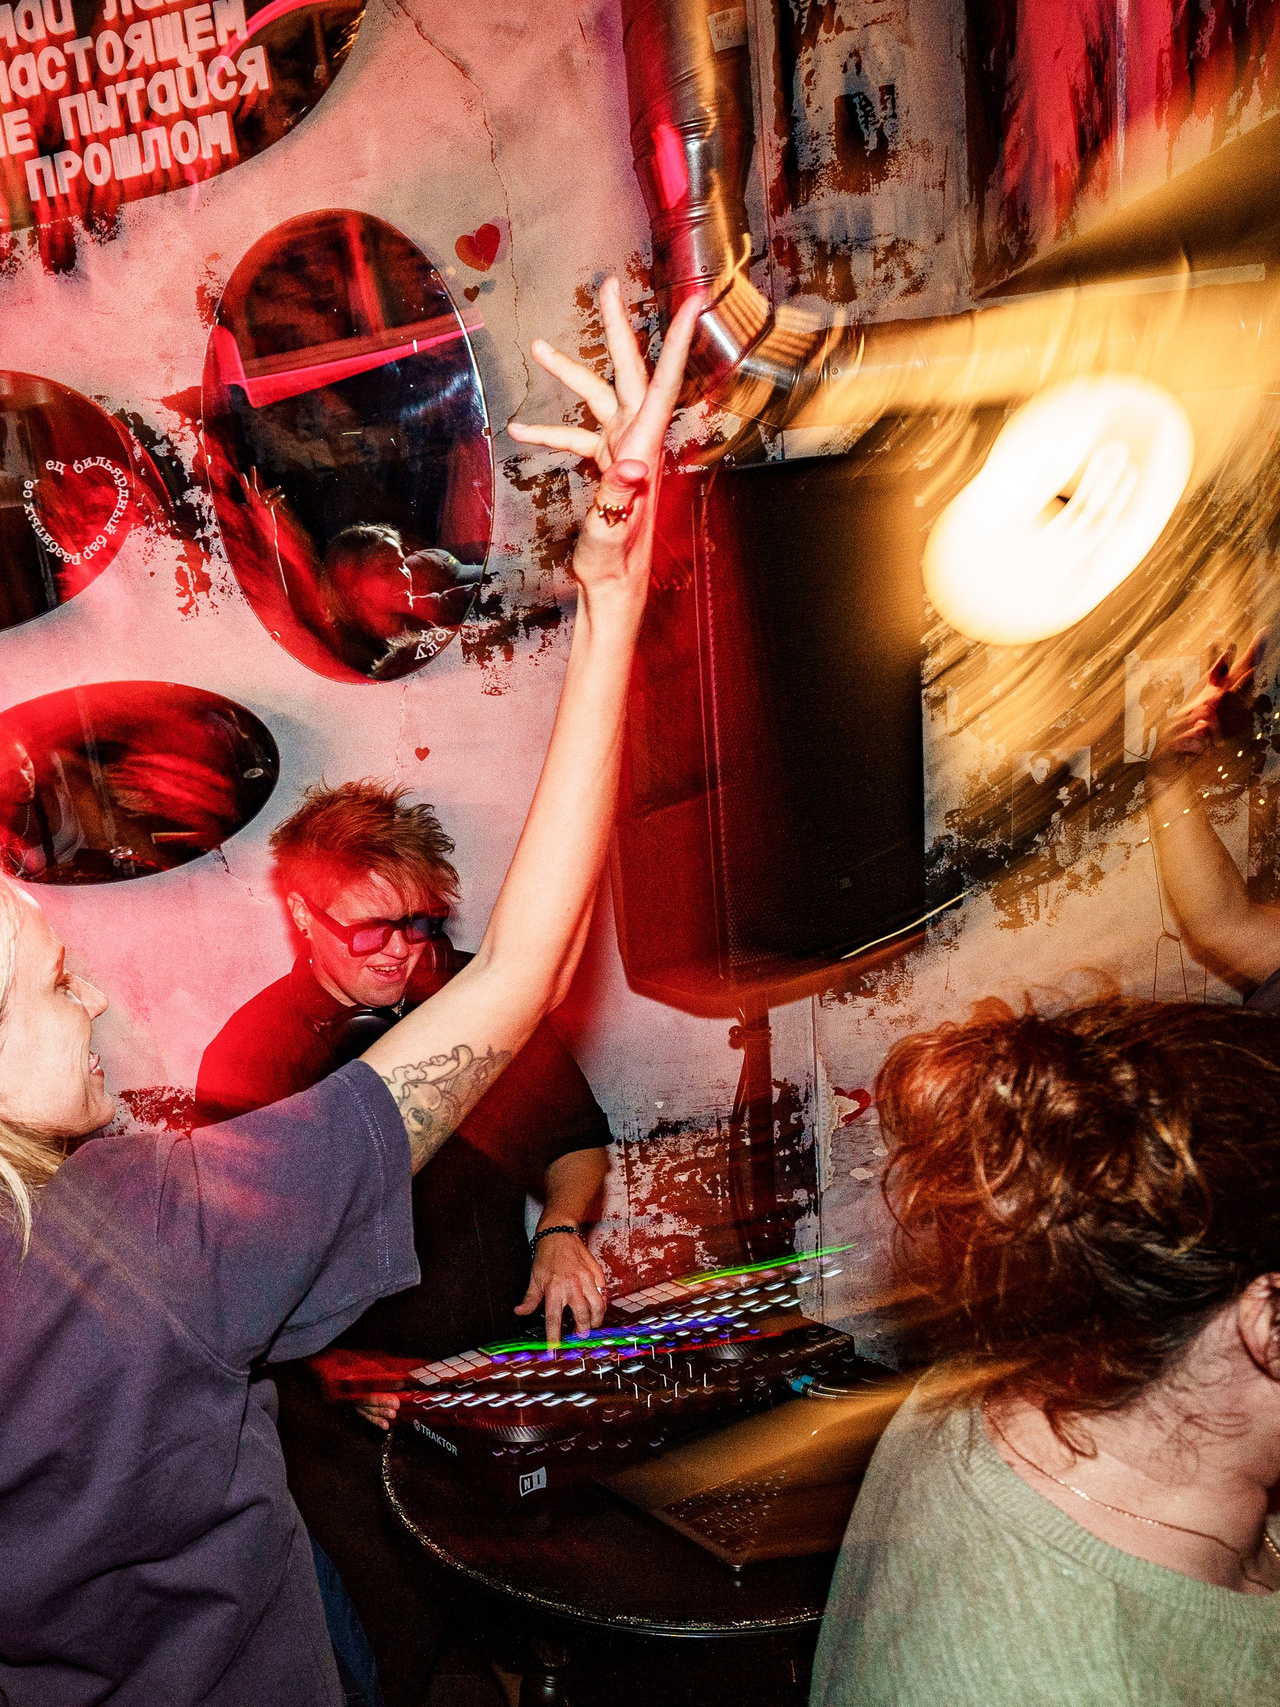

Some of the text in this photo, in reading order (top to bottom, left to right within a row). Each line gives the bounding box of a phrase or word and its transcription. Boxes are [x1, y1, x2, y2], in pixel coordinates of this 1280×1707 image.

[23, 502, 82, 566] разбитых
[83, 535, 108, 560] бар
[421, 1424, 458, 1456] TRAKTOR
